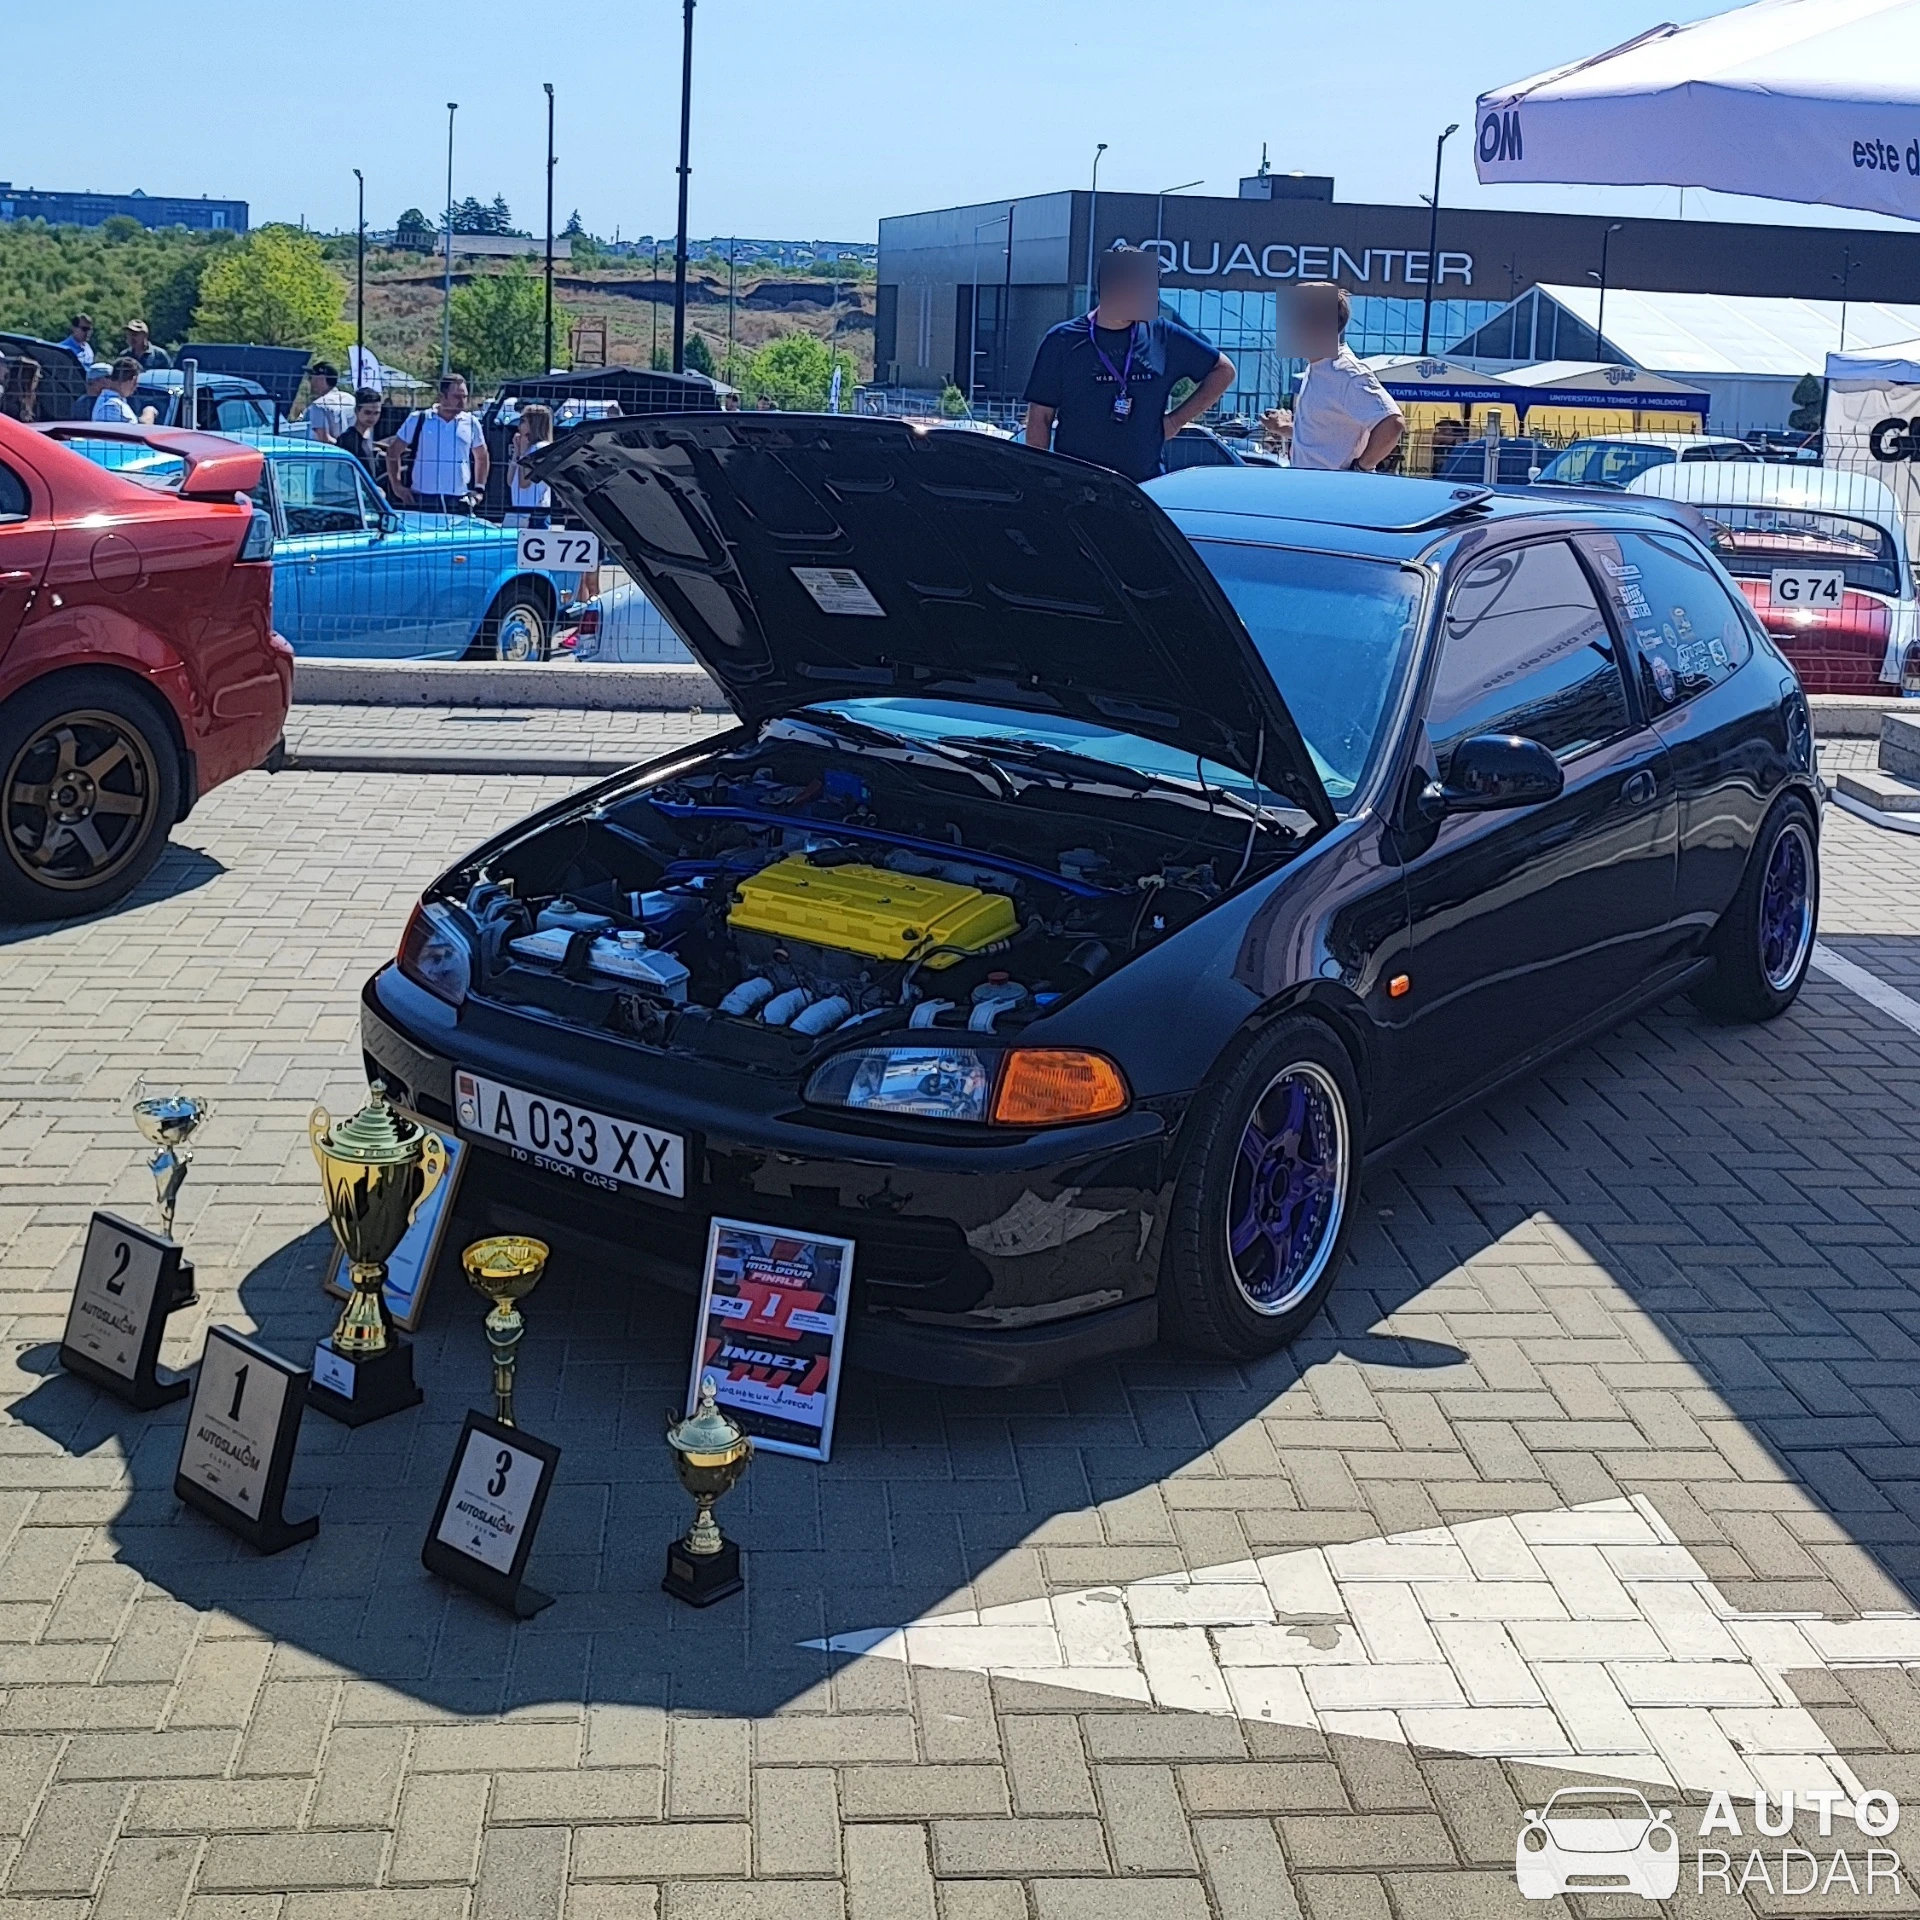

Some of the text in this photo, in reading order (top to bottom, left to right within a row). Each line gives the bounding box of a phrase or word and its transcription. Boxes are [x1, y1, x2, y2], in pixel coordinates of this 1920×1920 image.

[1853, 138, 1900, 173] este
[1112, 238, 1473, 286] QUACENTER
[523, 538, 591, 563] G 72
[1779, 578, 1838, 601] G 74
[494, 1090, 671, 1190] A 033 XX
[534, 1155, 576, 1179] STOCK
[583, 1171, 618, 1192] CARS
[106, 1242, 131, 1296] 2
[746, 1261, 813, 1279] MOLDOVA
[751, 1271, 804, 1288] FINALS
[721, 1345, 810, 1371] INDEX
[228, 1364, 249, 1422] 1
[487, 1450, 513, 1497] 3
